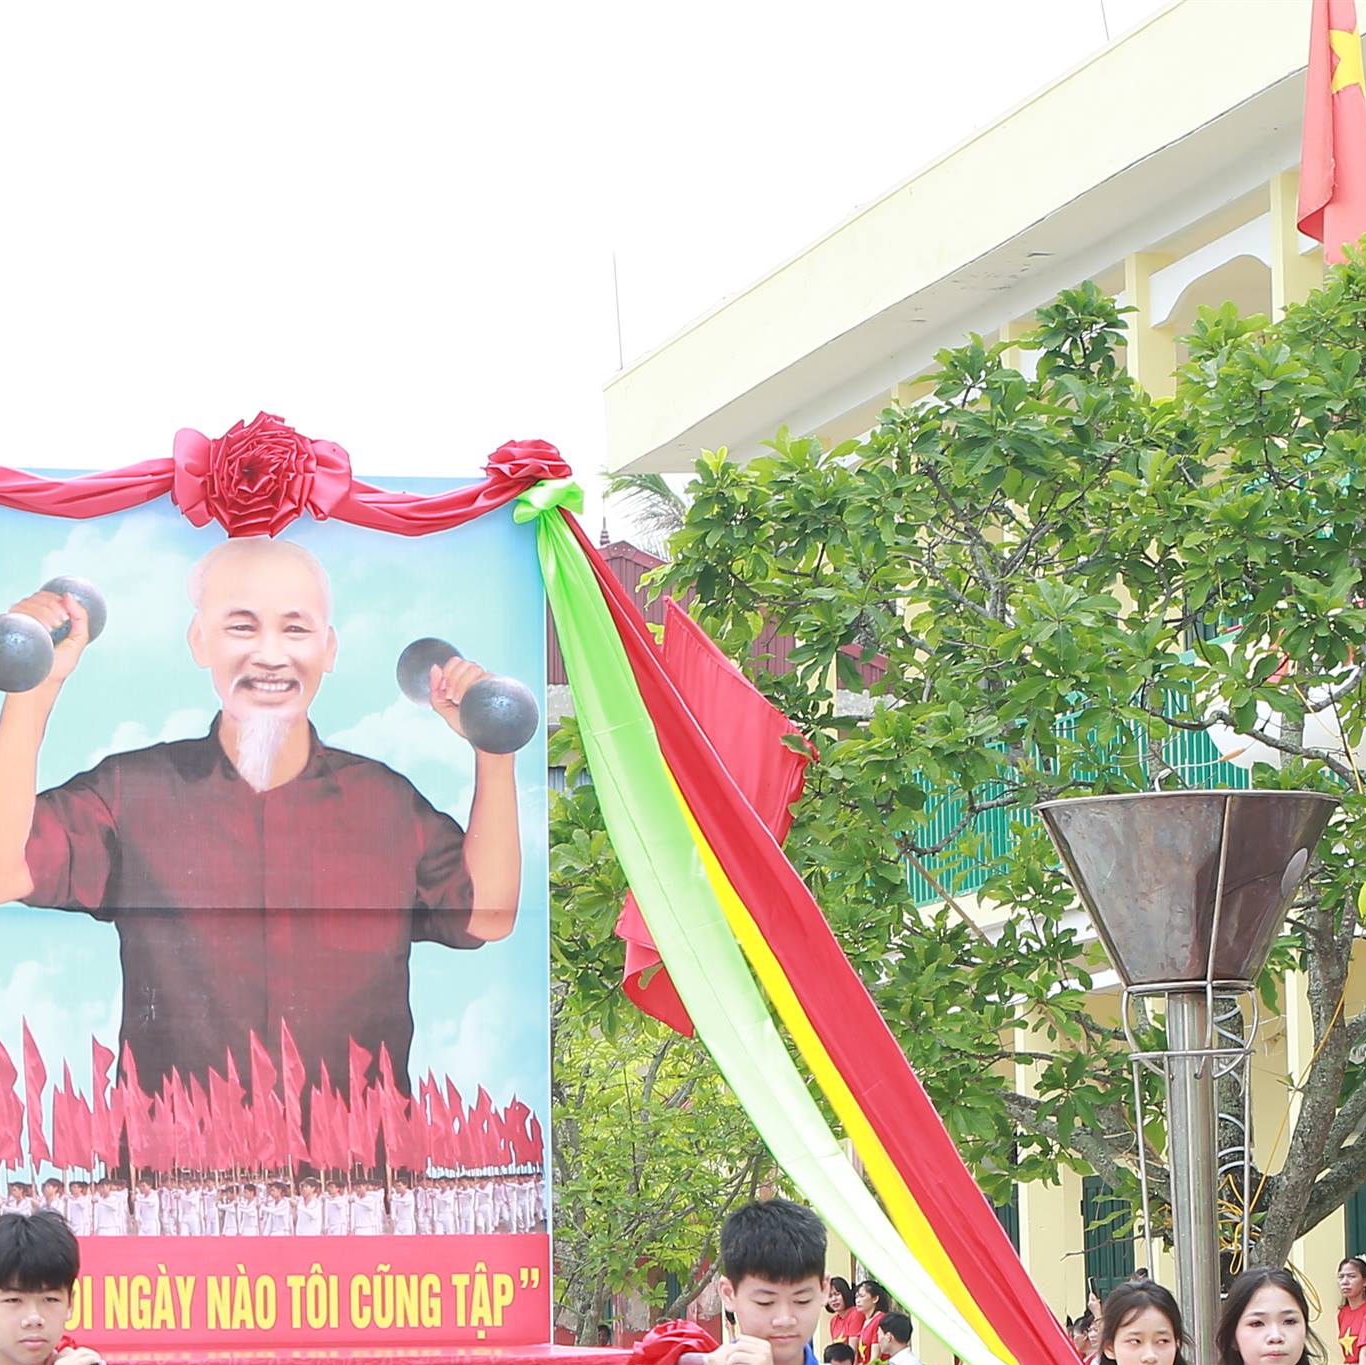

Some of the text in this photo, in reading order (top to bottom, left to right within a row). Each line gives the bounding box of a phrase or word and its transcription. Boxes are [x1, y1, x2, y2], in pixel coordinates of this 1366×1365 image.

[104, 1263, 196, 1330] NGÀY
[207, 1263, 276, 1330] NÀO
[286, 1263, 339, 1329] TÔI
[350, 1263, 442, 1329] CŨNG
